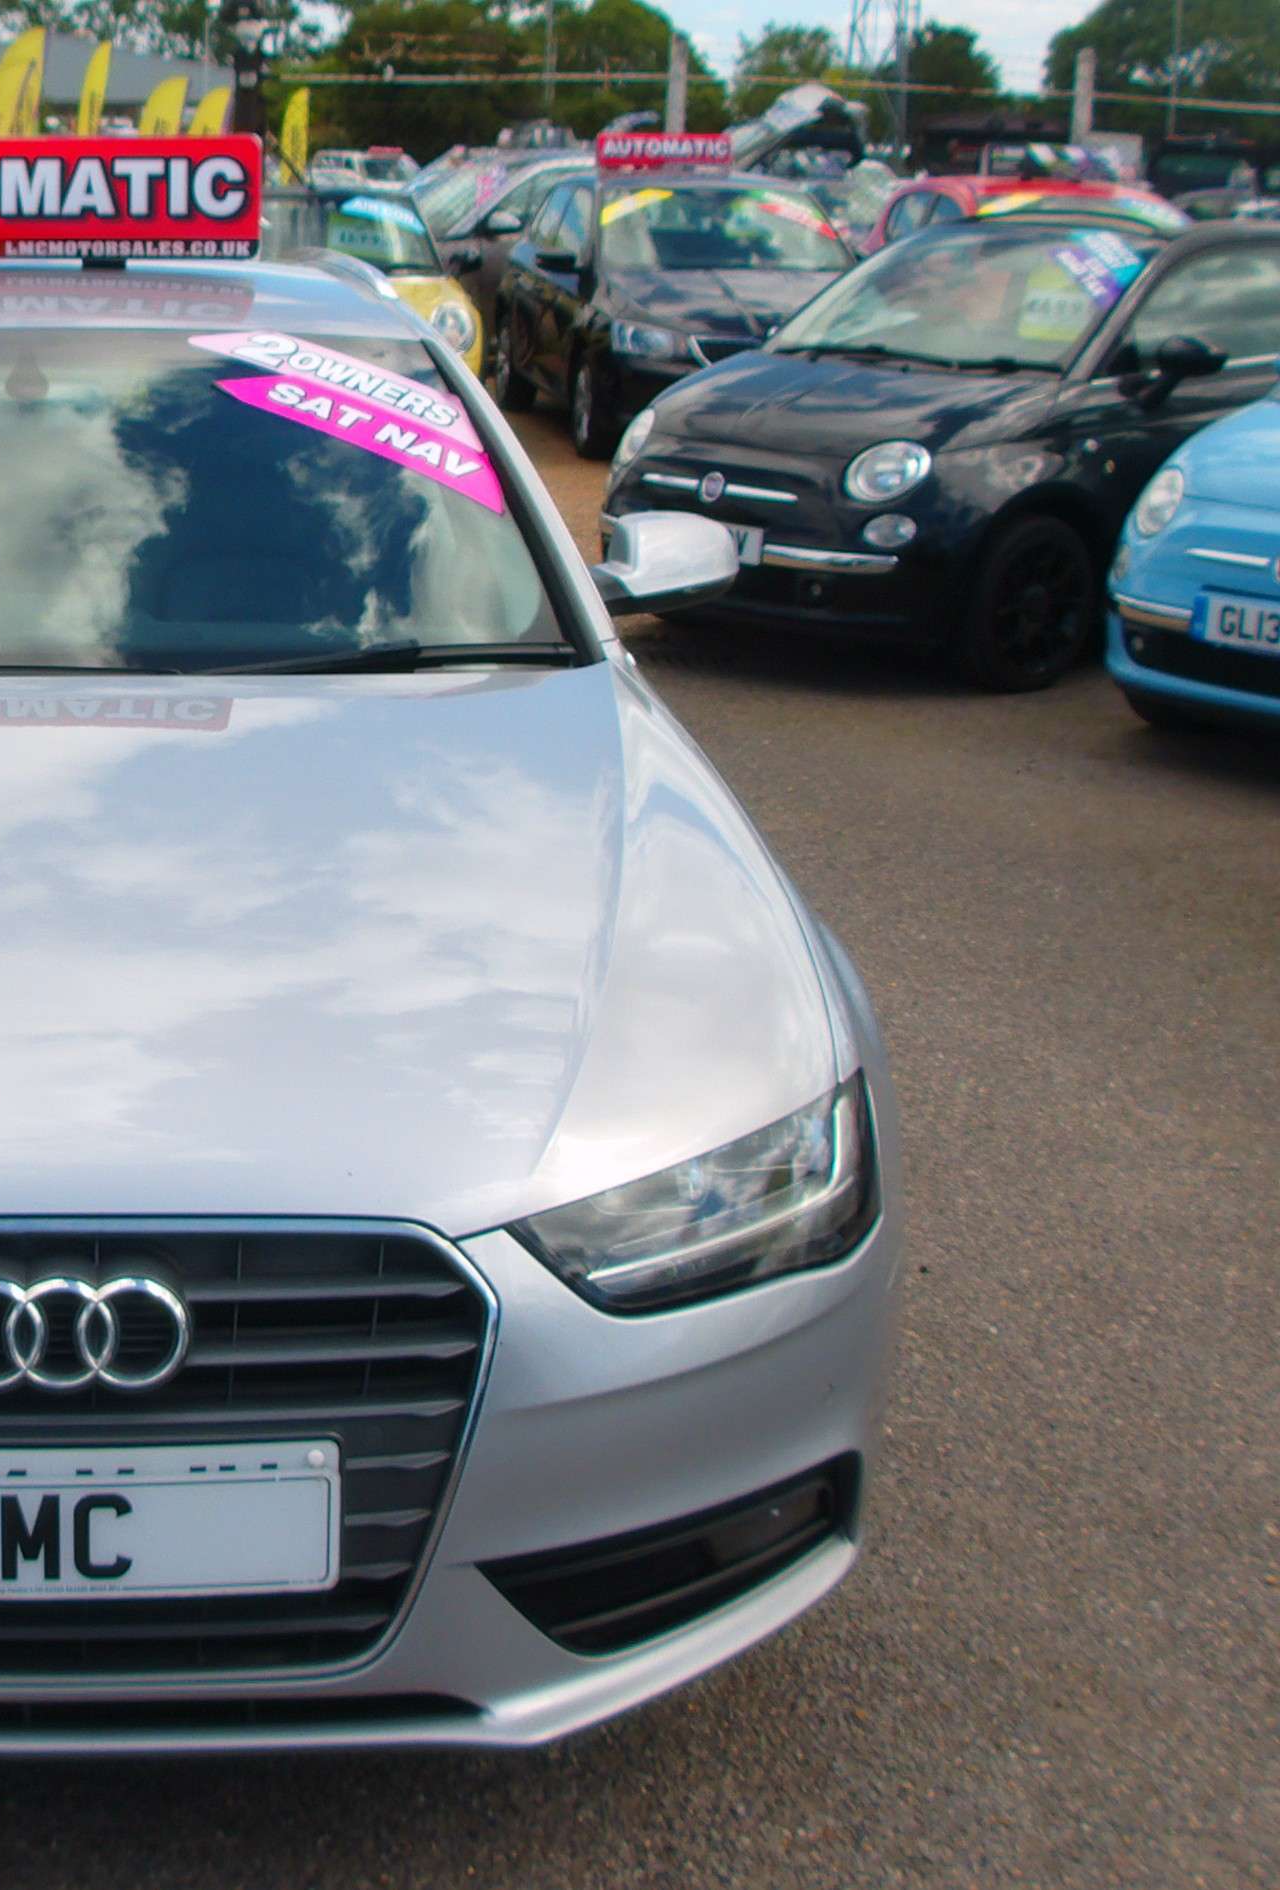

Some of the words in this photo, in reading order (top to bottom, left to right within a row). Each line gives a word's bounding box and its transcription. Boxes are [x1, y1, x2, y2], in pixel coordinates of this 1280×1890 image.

[604, 140, 729, 157] AUTOMATIC
[4, 240, 251, 257] LMCMOTORSALES.CO.UK
[232, 334, 298, 367] 2
[287, 353, 460, 428] OWNERS
[267, 382, 372, 429] SAT
[374, 422, 481, 476] NAV
